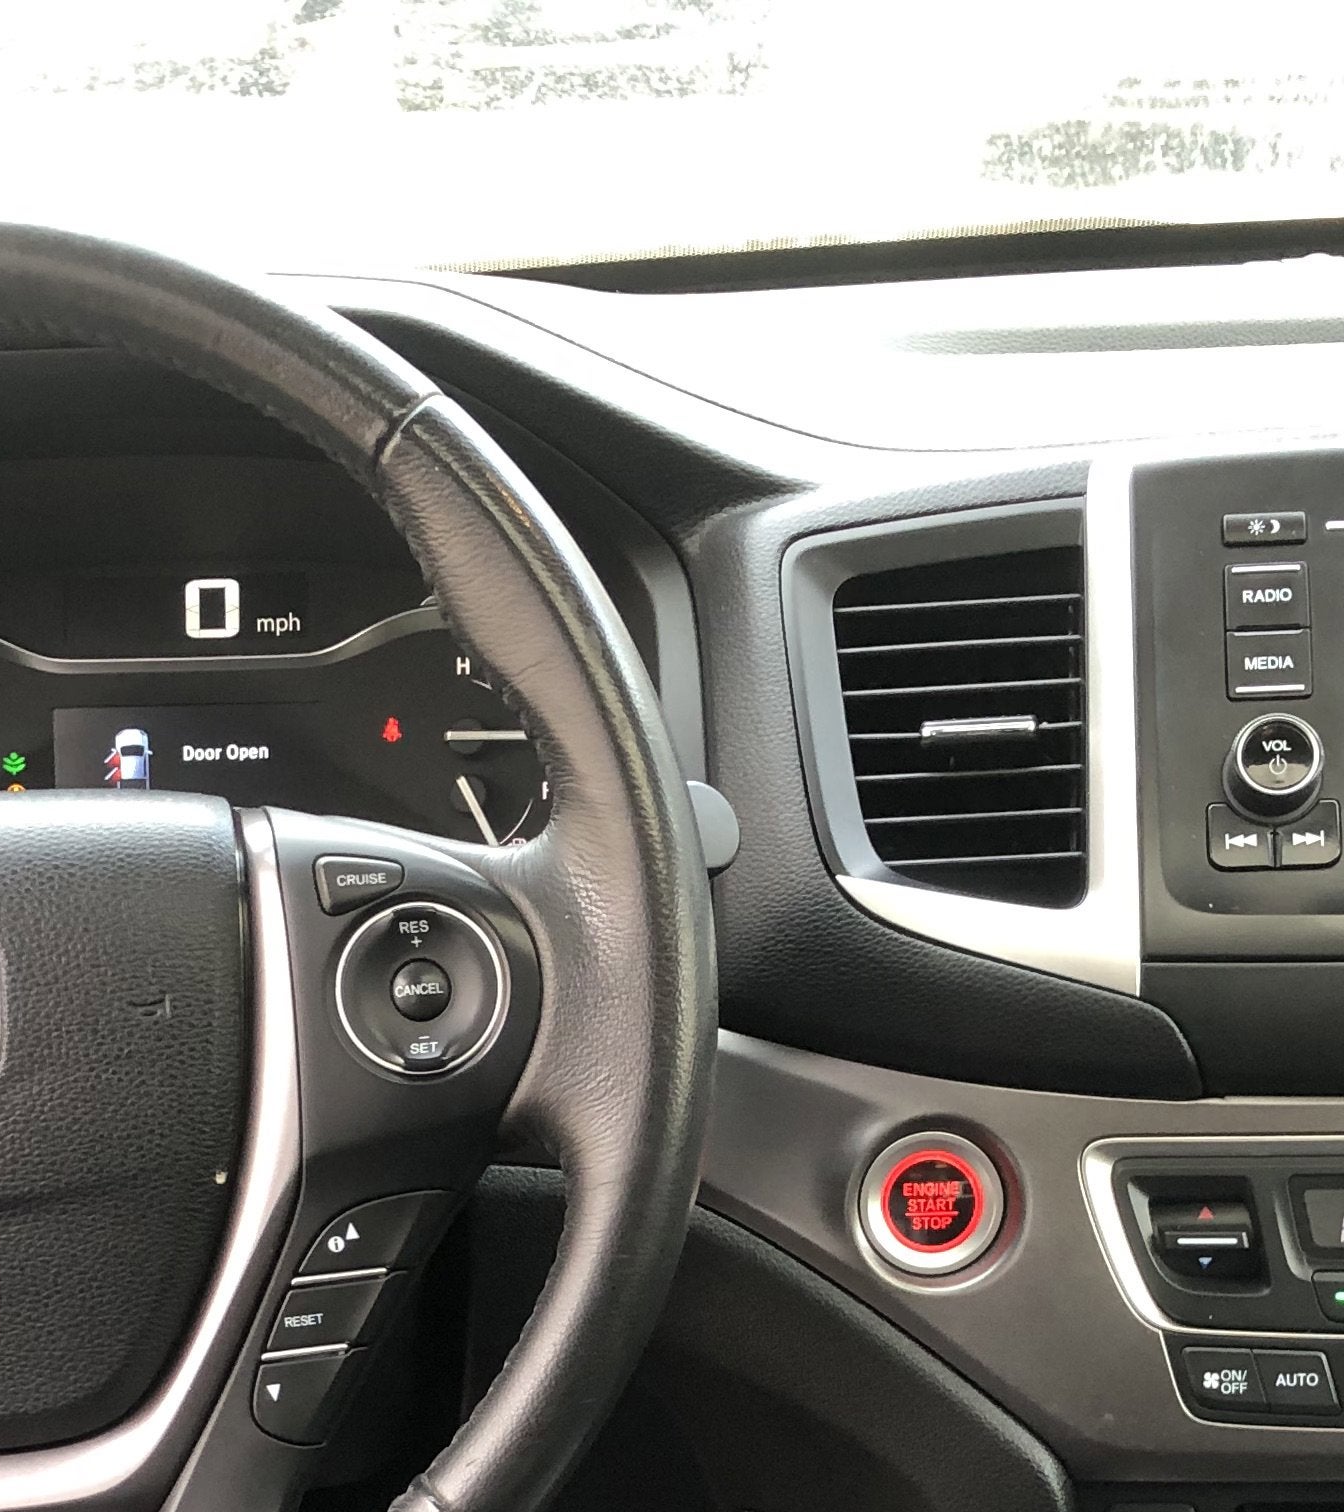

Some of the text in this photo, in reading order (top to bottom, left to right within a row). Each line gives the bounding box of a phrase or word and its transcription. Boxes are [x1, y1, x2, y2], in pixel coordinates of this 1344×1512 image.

[1242, 587, 1293, 603] RADIO
[185, 578, 301, 638] 0 mph
[456, 656, 471, 675] H
[1244, 655, 1294, 670] MEDIA
[182, 743, 270, 761] Door Open
[1262, 739, 1292, 752] VOL
[336, 872, 387, 887] CRUISE
[399, 919, 430, 934] RES
[394, 982, 445, 998] CANCEL
[410, 1041, 439, 1055] SET
[902, 1181, 961, 1198] ENGINE
[907, 1198, 957, 1213] START
[912, 1216, 953, 1231] STOP
[284, 1312, 324, 1328] RESET
[1221, 1369, 1248, 1382] ON/
[1275, 1373, 1319, 1387] AUTO
[1220, 1382, 1248, 1394] OFF
